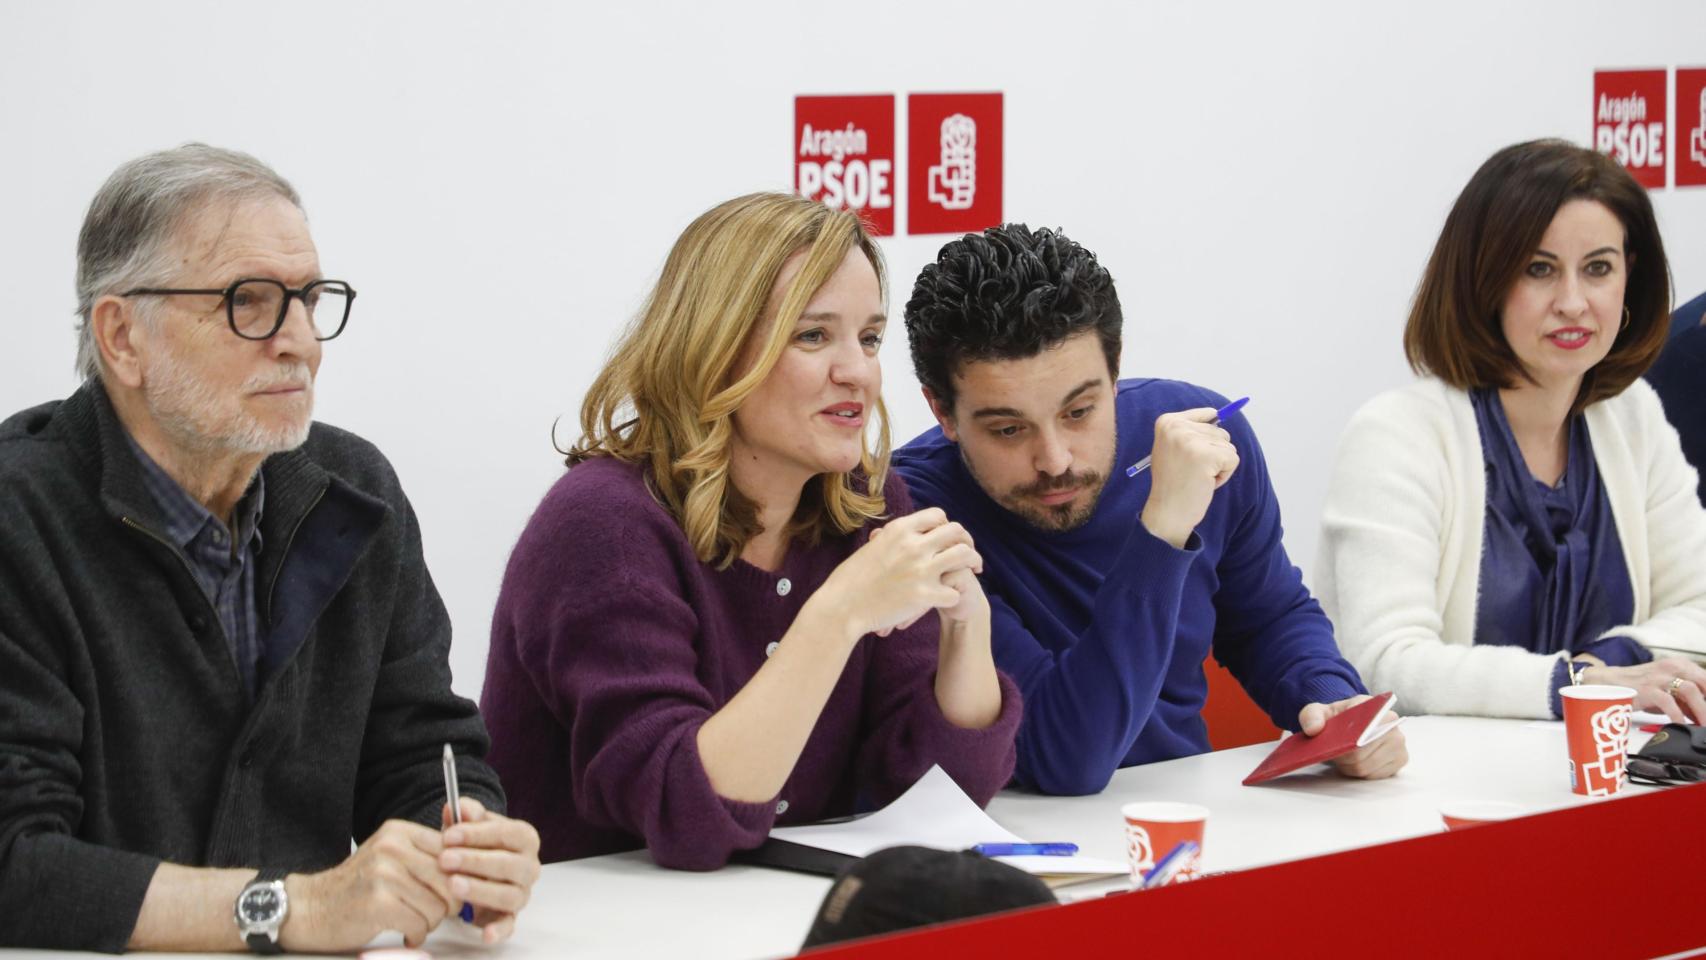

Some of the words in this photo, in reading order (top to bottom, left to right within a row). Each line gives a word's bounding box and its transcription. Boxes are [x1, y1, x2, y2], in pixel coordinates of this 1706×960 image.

[1597, 91, 1647, 125] Aragón
[800, 122, 868, 161] Aragón
[1597, 123, 1663, 167] PSOE
[799, 160, 892, 208] PSOE
